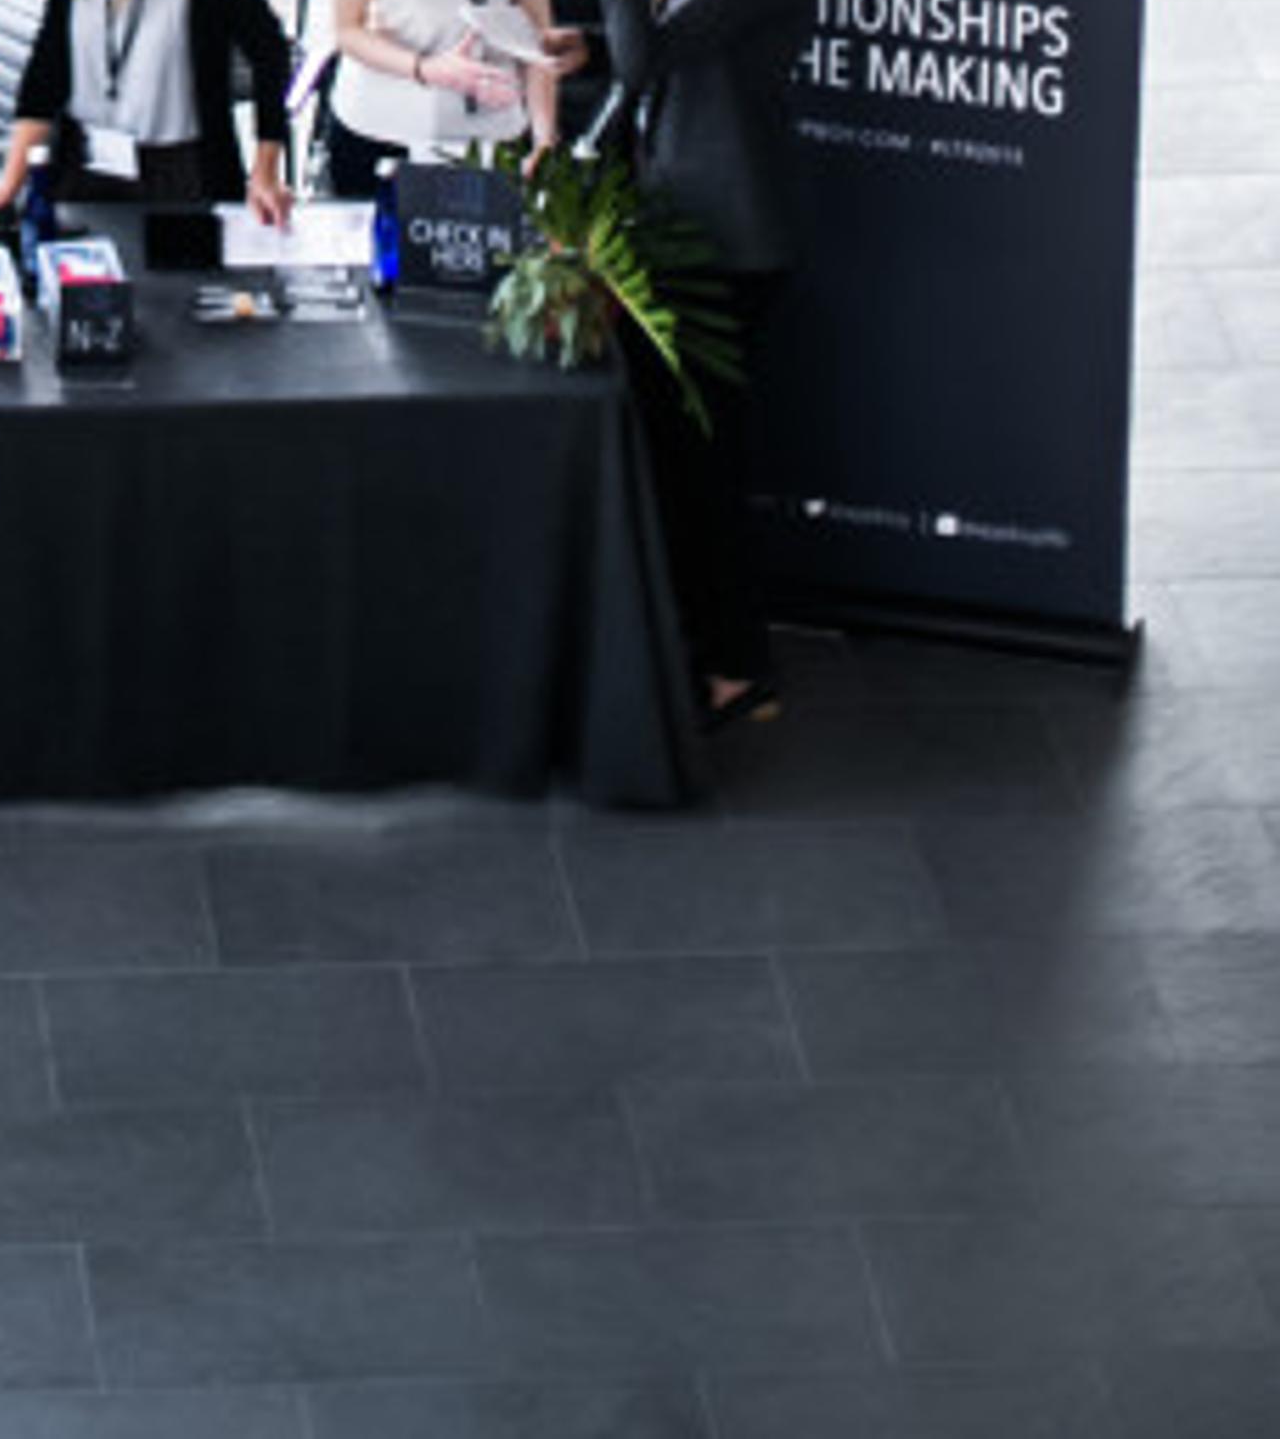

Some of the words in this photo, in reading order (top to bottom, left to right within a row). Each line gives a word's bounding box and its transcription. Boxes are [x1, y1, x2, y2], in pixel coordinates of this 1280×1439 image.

[791, 37, 851, 91] HE
[867, 44, 1066, 118] MAKING
[408, 217, 480, 246] CHECK
